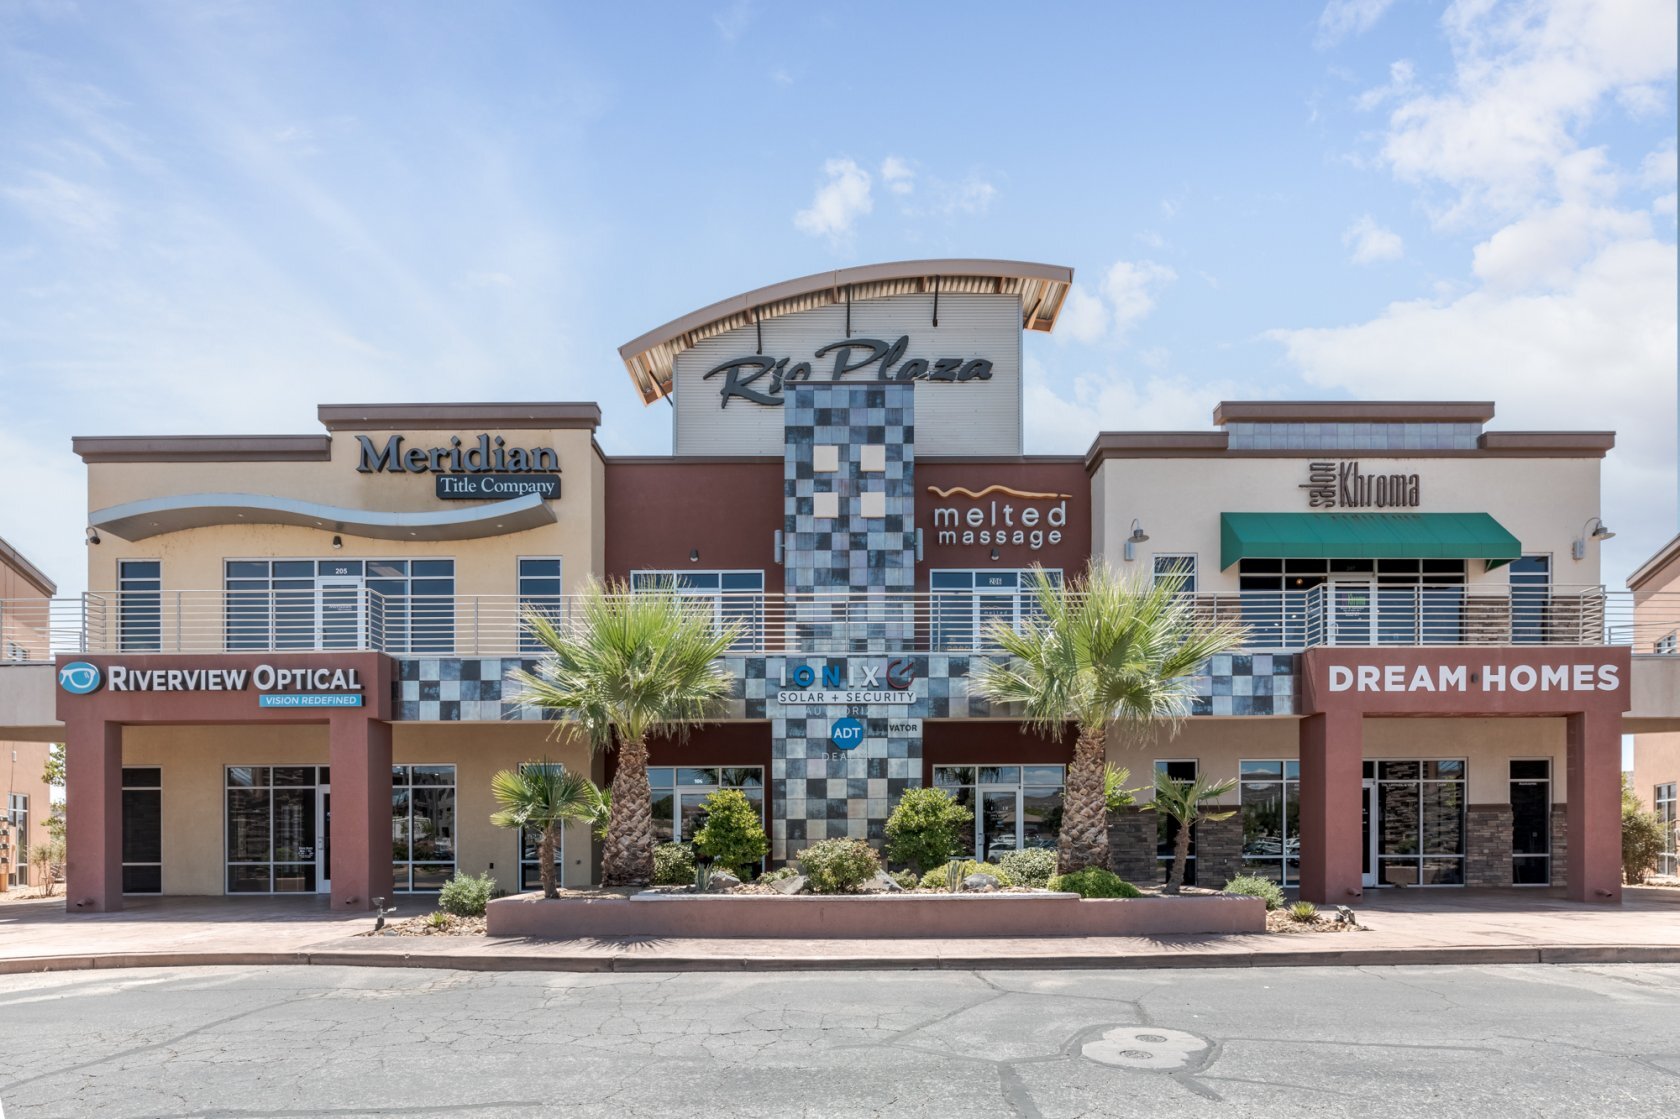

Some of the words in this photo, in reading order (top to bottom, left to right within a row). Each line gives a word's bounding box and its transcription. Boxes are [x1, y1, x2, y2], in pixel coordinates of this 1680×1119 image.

[703, 356, 811, 409] Rio
[815, 335, 994, 382] Plaza
[355, 433, 562, 473] Meridian
[440, 477, 477, 493] Title
[480, 477, 555, 496] Company
[1298, 462, 1337, 508] salon
[1339, 461, 1420, 508] Khroma
[934, 501, 1066, 527] melted
[939, 530, 1062, 549] massage
[108, 666, 247, 691] RIVERVIEW
[253, 664, 362, 690] OPTICAL
[780, 665, 880, 688] IONIX
[1328, 665, 1467, 692] DREAM
[1482, 664, 1620, 691] HOMES
[266, 696, 299, 705] VISION
[301, 696, 357, 705] REDEFINED
[780, 692, 825, 702] SOLAR
[846, 692, 914, 702] SECURITY
[833, 727, 861, 739] ADT
